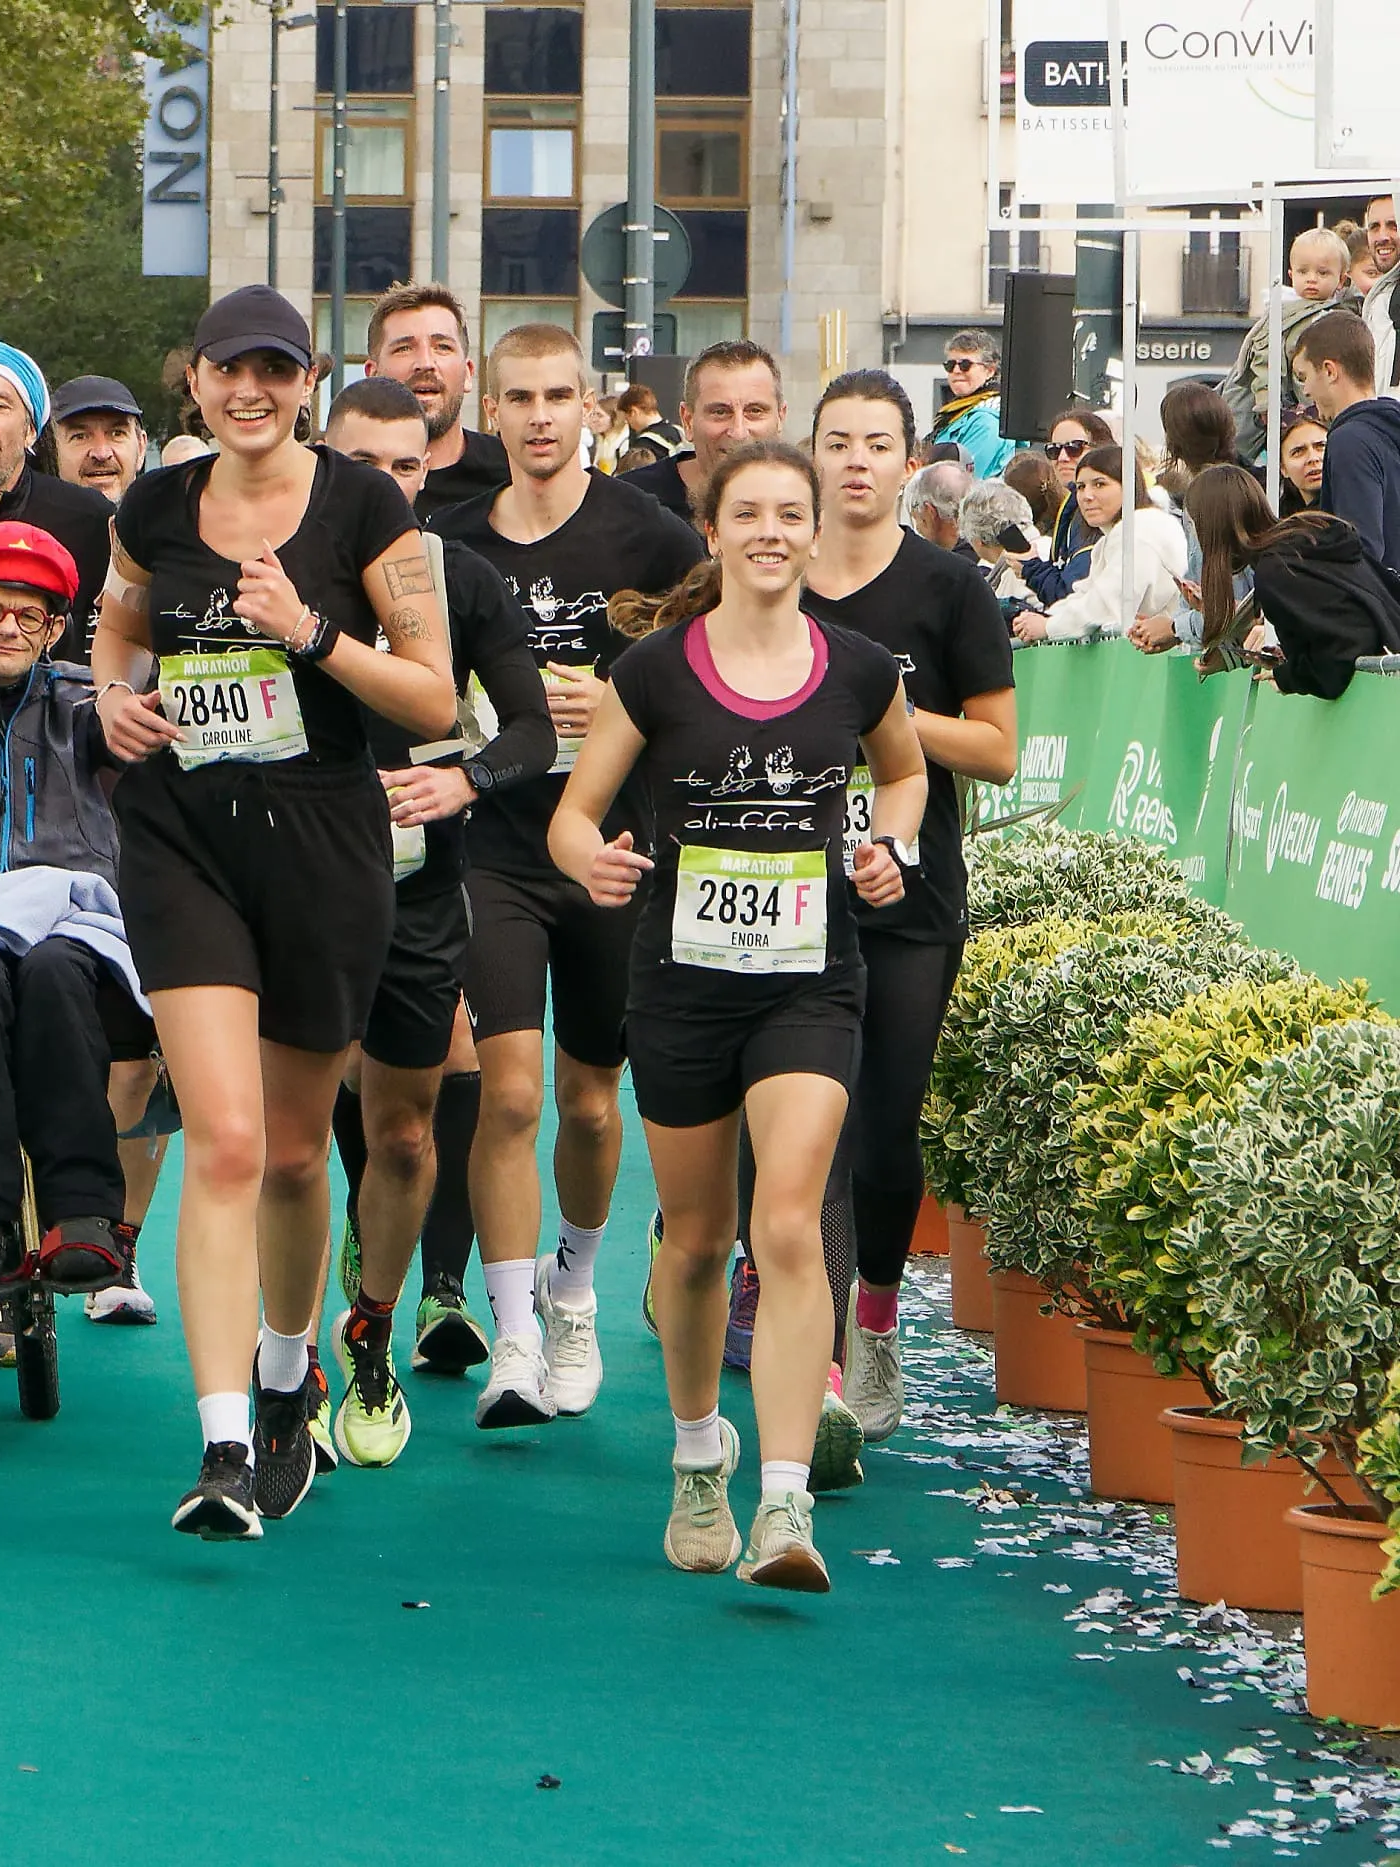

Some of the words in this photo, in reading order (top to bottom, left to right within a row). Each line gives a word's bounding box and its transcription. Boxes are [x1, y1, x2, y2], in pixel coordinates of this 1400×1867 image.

[184, 659, 250, 676] MARATHON
[174, 683, 249, 727] 2840
[259, 679, 277, 719] F
[202, 729, 253, 746] CAROLINE
[720, 856, 794, 875] MARATHON
[696, 880, 781, 927] 2834
[795, 884, 811, 926] F
[731, 931, 769, 948] ENORA
